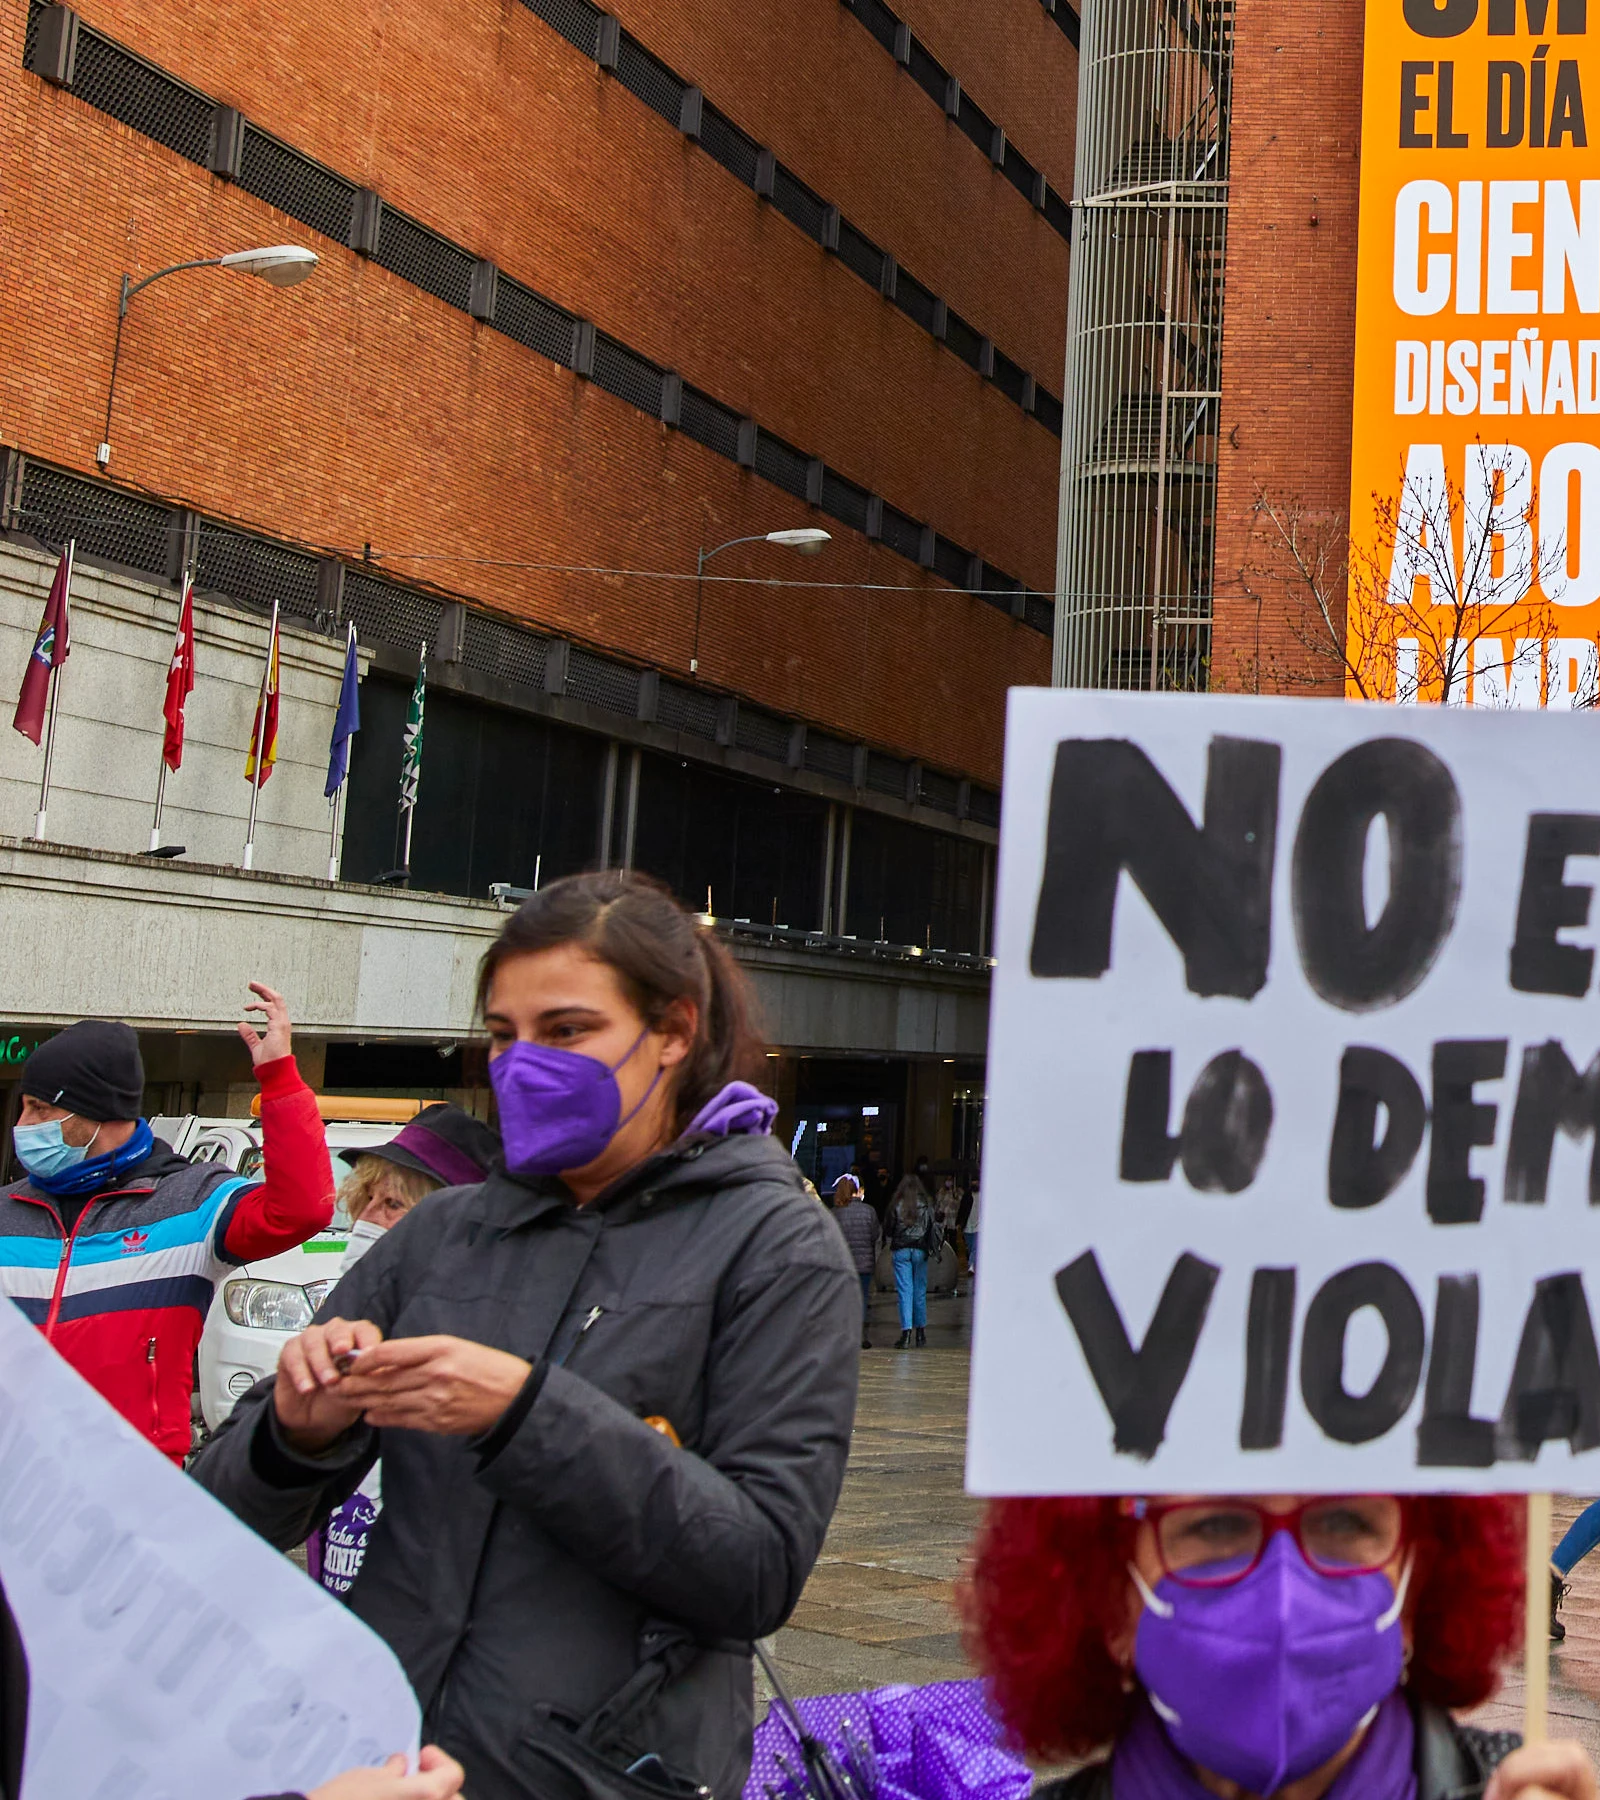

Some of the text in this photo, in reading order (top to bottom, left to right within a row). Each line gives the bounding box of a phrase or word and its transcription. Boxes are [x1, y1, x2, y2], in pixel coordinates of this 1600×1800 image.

[1399, 60, 1469, 149] EL
[1485, 44, 1588, 149] DÍA
[1029, 734, 1465, 1015] NO
[1118, 1047, 1275, 1195] LO
